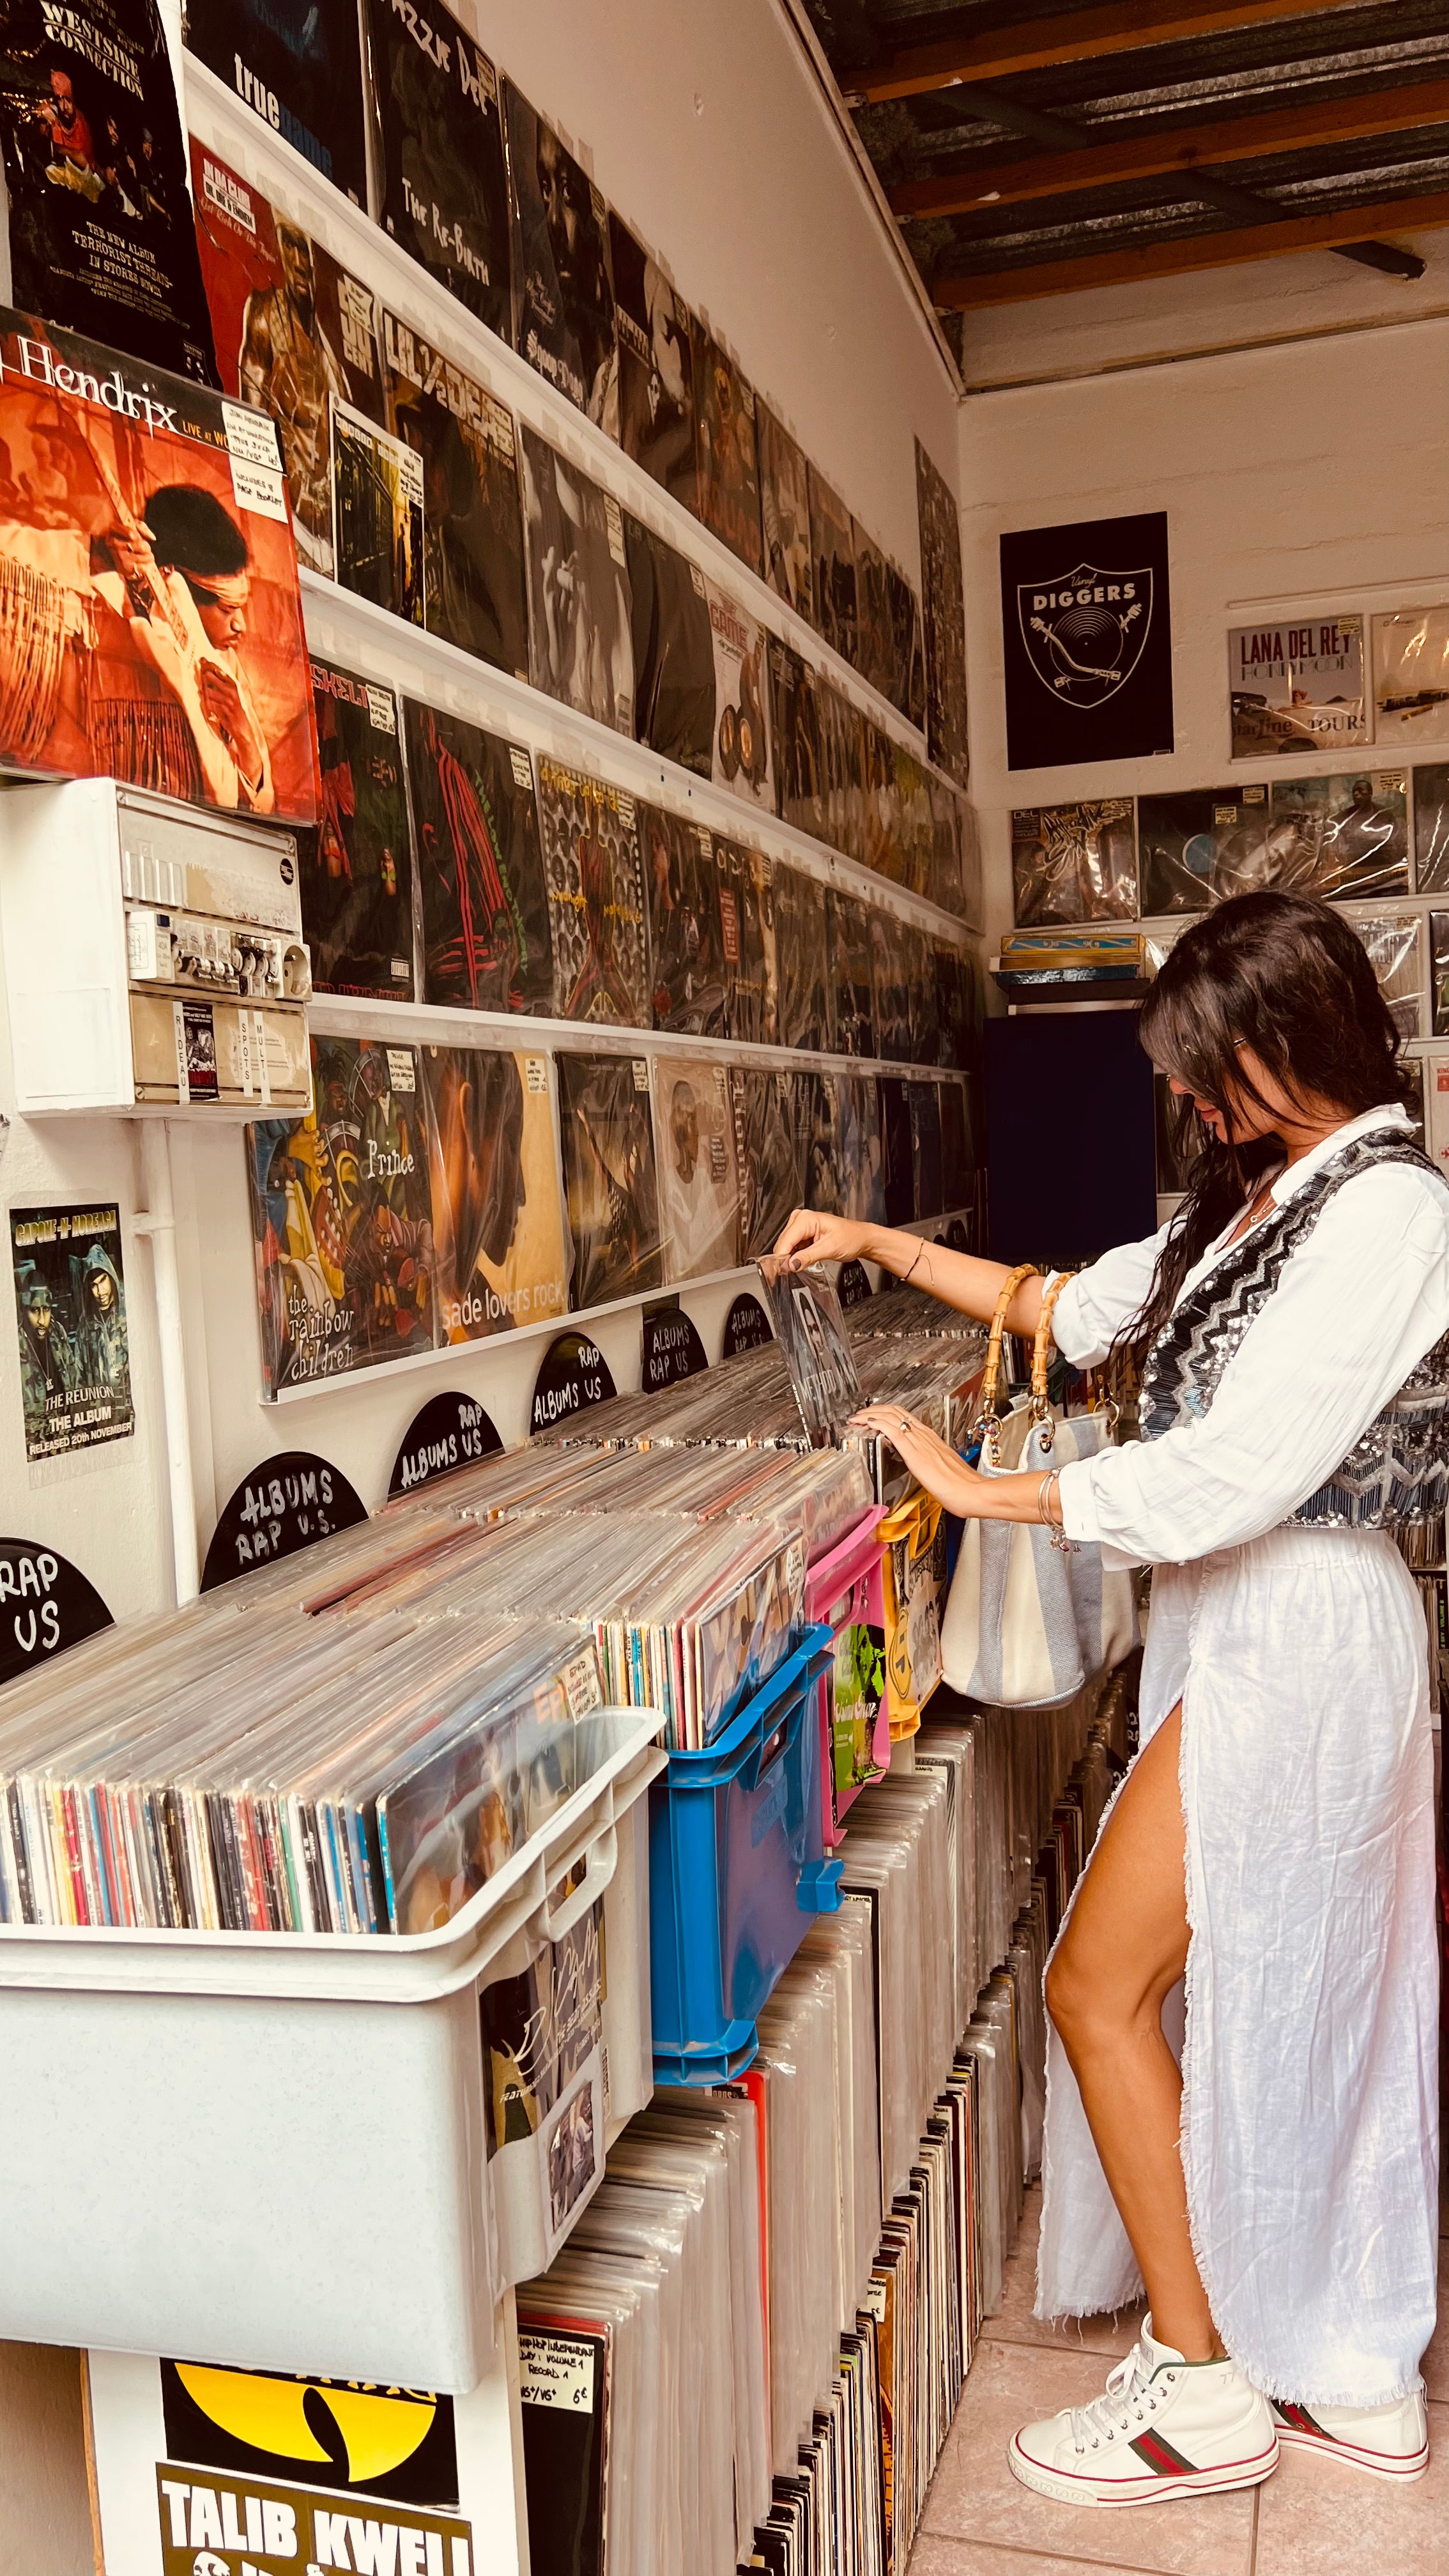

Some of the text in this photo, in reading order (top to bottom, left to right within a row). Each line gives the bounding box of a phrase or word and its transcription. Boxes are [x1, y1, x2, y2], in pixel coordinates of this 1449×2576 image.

[40, 0, 141, 82] WESTSIDE
[45, 25, 144, 101] CONNECTION
[72, 230, 132, 266] TERRORIST
[86, 220, 156, 264] THE NEW ALBUM
[89, 254, 100, 268] IN
[103, 259, 139, 284] STORES
[17, 335, 180, 441] Hendrix
[182, 420, 202, 440] LIVE
[204, 431, 213, 443] AT
[237, 483, 252, 496] PAGE
[1033, 582, 1137, 611] DIGGERS
[709, 599, 749, 655] GAME
[1241, 631, 1284, 665] LANA
[1289, 627, 1317, 660] DEL
[1241, 655, 1353, 682] HONEYMOON
[176, 1015, 187, 1087] RIDEAU
[241, 1023, 250, 1080] SPOTS
[256, 1025, 266, 1080] MULTI
[367, 1138, 415, 1179] Prince
[15, 1220, 58, 1246] CAPONE
[72, 1209, 117, 1238] NOREAGA
[288, 1285, 309, 1315] the
[442, 1278, 565, 1331] sade lovers rock
[289, 1301, 354, 1342] rainbow
[653, 1322, 689, 1354] ALBUMS
[732, 1308, 762, 1335] ALBUMS
[291, 1340, 354, 1381] children
[578, 1346, 600, 1369] RAP
[650, 1350, 689, 1383] RAP US
[45, 1385, 115, 1412] THE REUNION
[458, 1404, 483, 1429] RAP
[533, 1376, 602, 1425] ALBUMS US
[29, 1422, 132, 1455] RELEASED 20th NOVEMBER
[49, 1406, 112, 1433] THE ALBUM
[401, 1428, 482, 1489] ALBUMS US
[240, 1469, 334, 1526] ALBUMS
[235, 1519, 282, 1565] RAP
[0, 1553, 58, 1603] RAP
[14, 1600, 60, 1652] US
[528, 2363, 560, 2379] RECORD
[546, 2354, 576, 2368] VOLUME
[161, 2480, 298, 2558] TALIB
